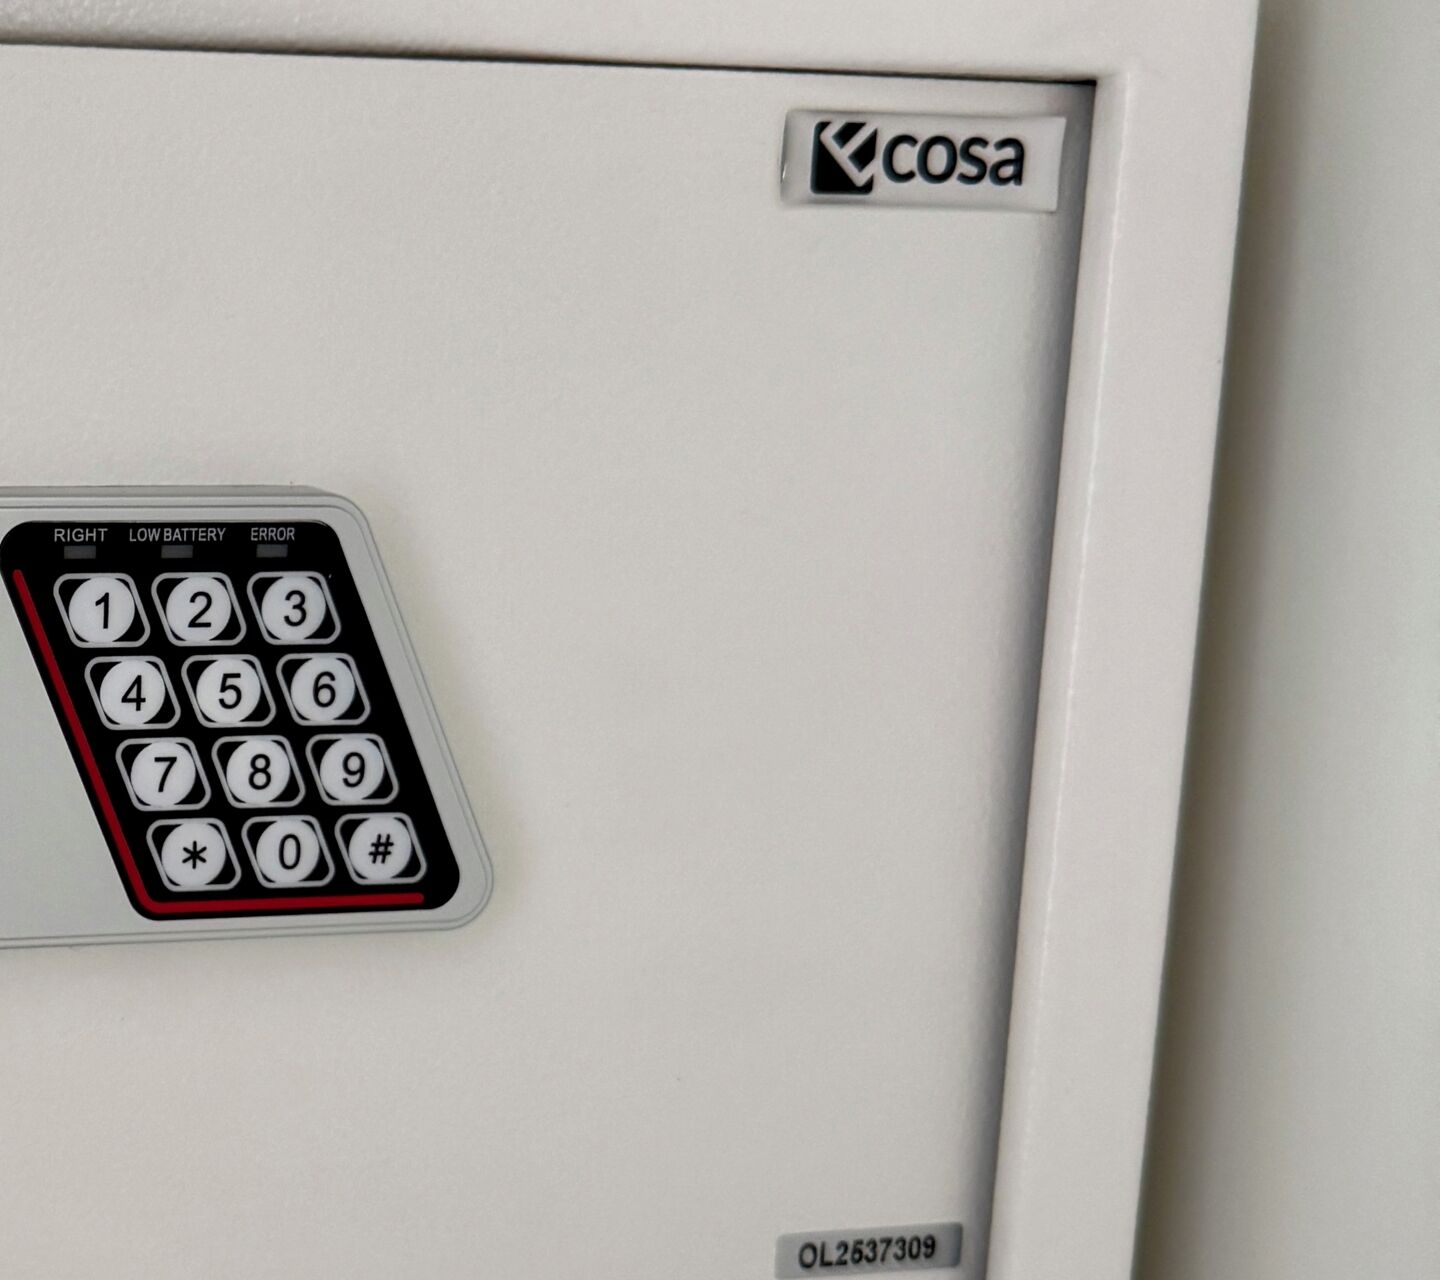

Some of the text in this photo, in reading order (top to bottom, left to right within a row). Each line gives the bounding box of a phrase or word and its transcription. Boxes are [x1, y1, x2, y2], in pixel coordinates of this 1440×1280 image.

[882, 134, 1026, 187] cosa
[54, 529, 108, 542] RIGHT
[129, 528, 226, 542] LOW BATTERY
[251, 527, 295, 541] ERROR
[95, 592, 110, 630] 1
[187, 591, 213, 629] 2
[283, 590, 307, 627] 3
[121, 674, 147, 712] 4
[218, 672, 242, 710] 5
[312, 671, 336, 708] 6
[154, 756, 178, 793] 7
[248, 753, 272, 791] 8
[342, 752, 366, 788] 9
[278, 833, 302, 871] 0
